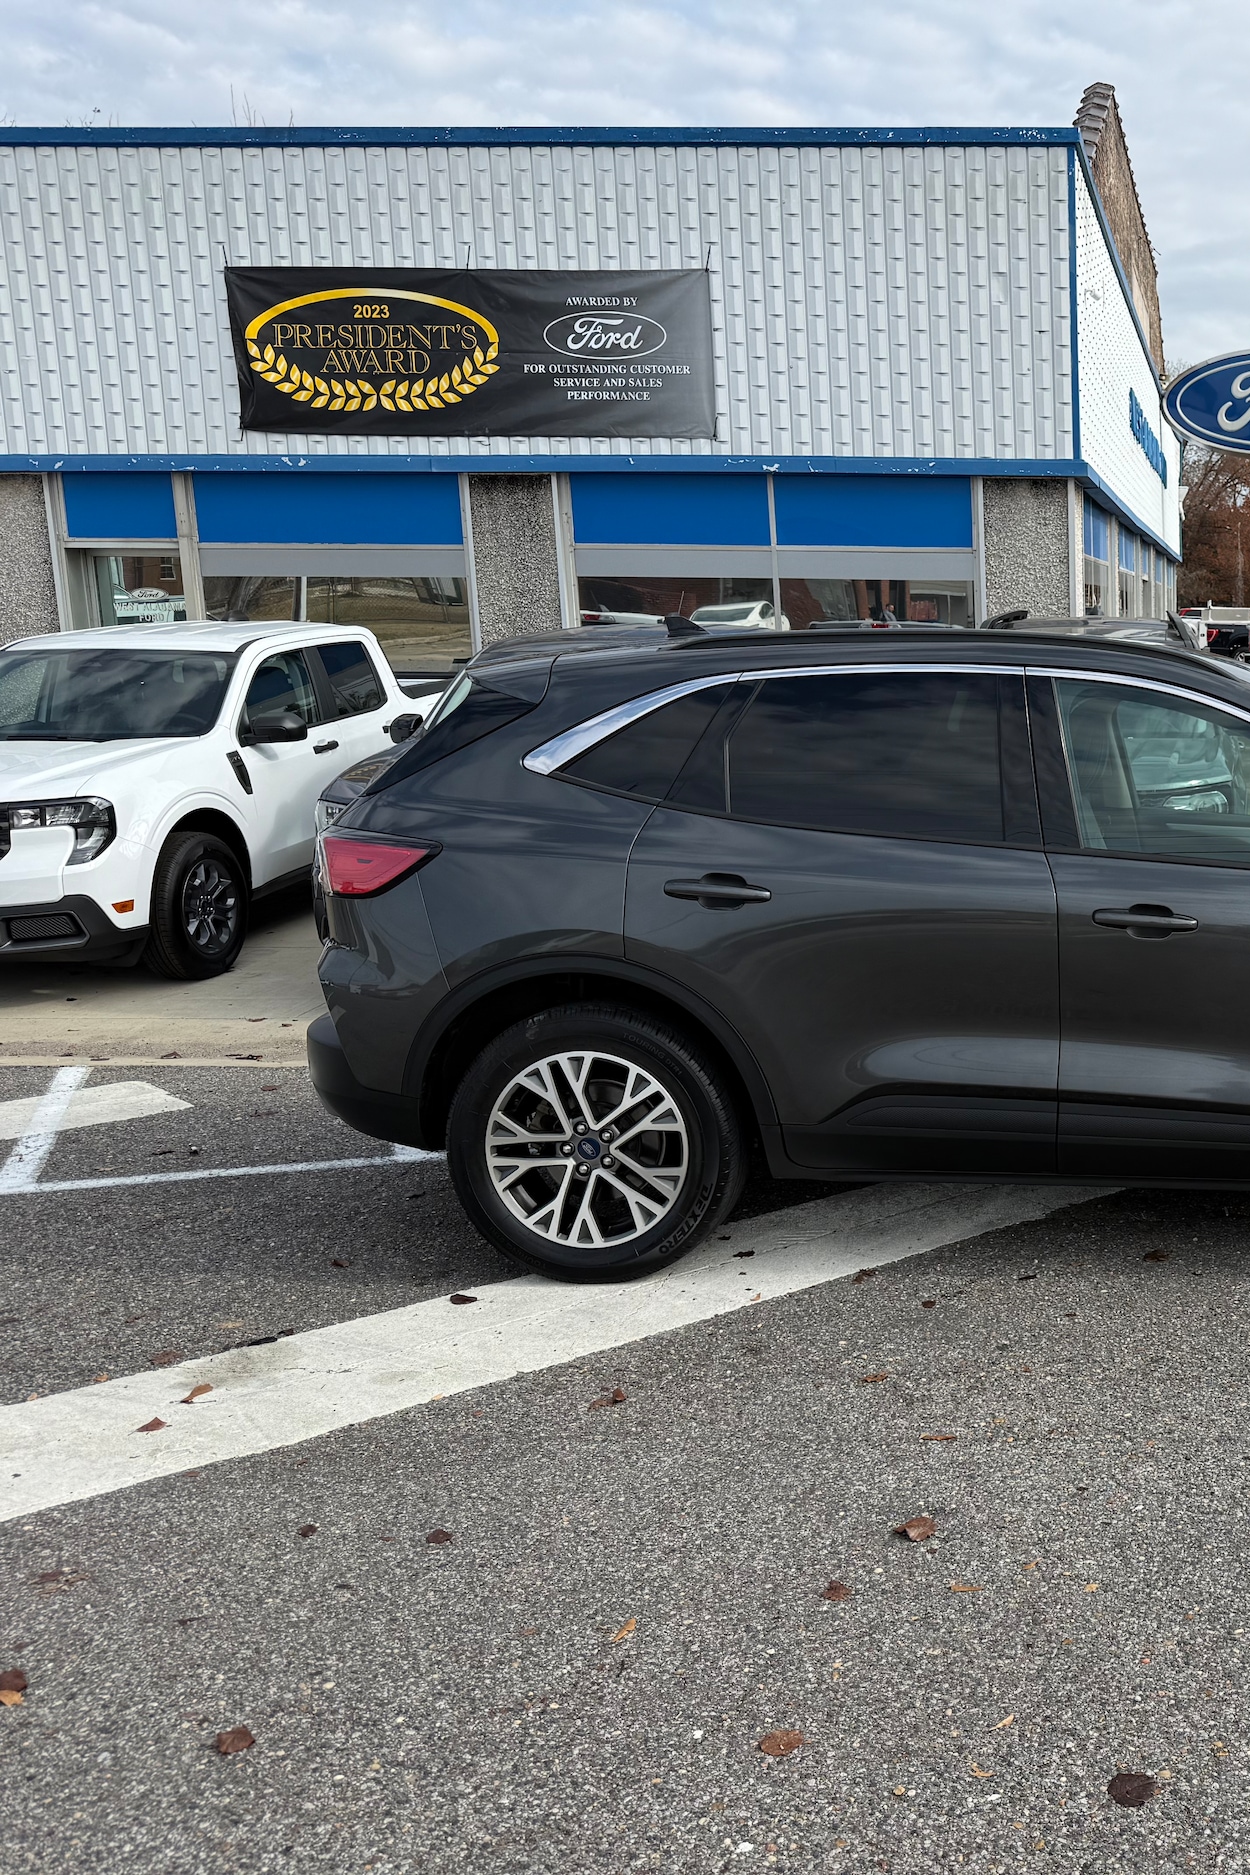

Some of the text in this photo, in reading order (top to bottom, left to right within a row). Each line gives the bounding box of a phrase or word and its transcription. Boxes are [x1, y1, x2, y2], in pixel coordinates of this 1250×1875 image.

[565, 296, 638, 306] AWARDED BY
[352, 304, 390, 319] 2023
[272, 323, 478, 350] PRESIDENT'S
[566, 317, 644, 350] Ford
[320, 349, 431, 374] AWARD
[523, 363, 691, 375] FOR OUTSTANDING CUSTOMER
[553, 377, 663, 388] SERVICE AND SALES
[567, 391, 651, 401] PERFORMANCE
[136, 588, 159, 599] Ford
[113, 602, 140, 612] WEST
[139, 612, 165, 622] FORD
[623, 1032, 666, 1060] TOURING
